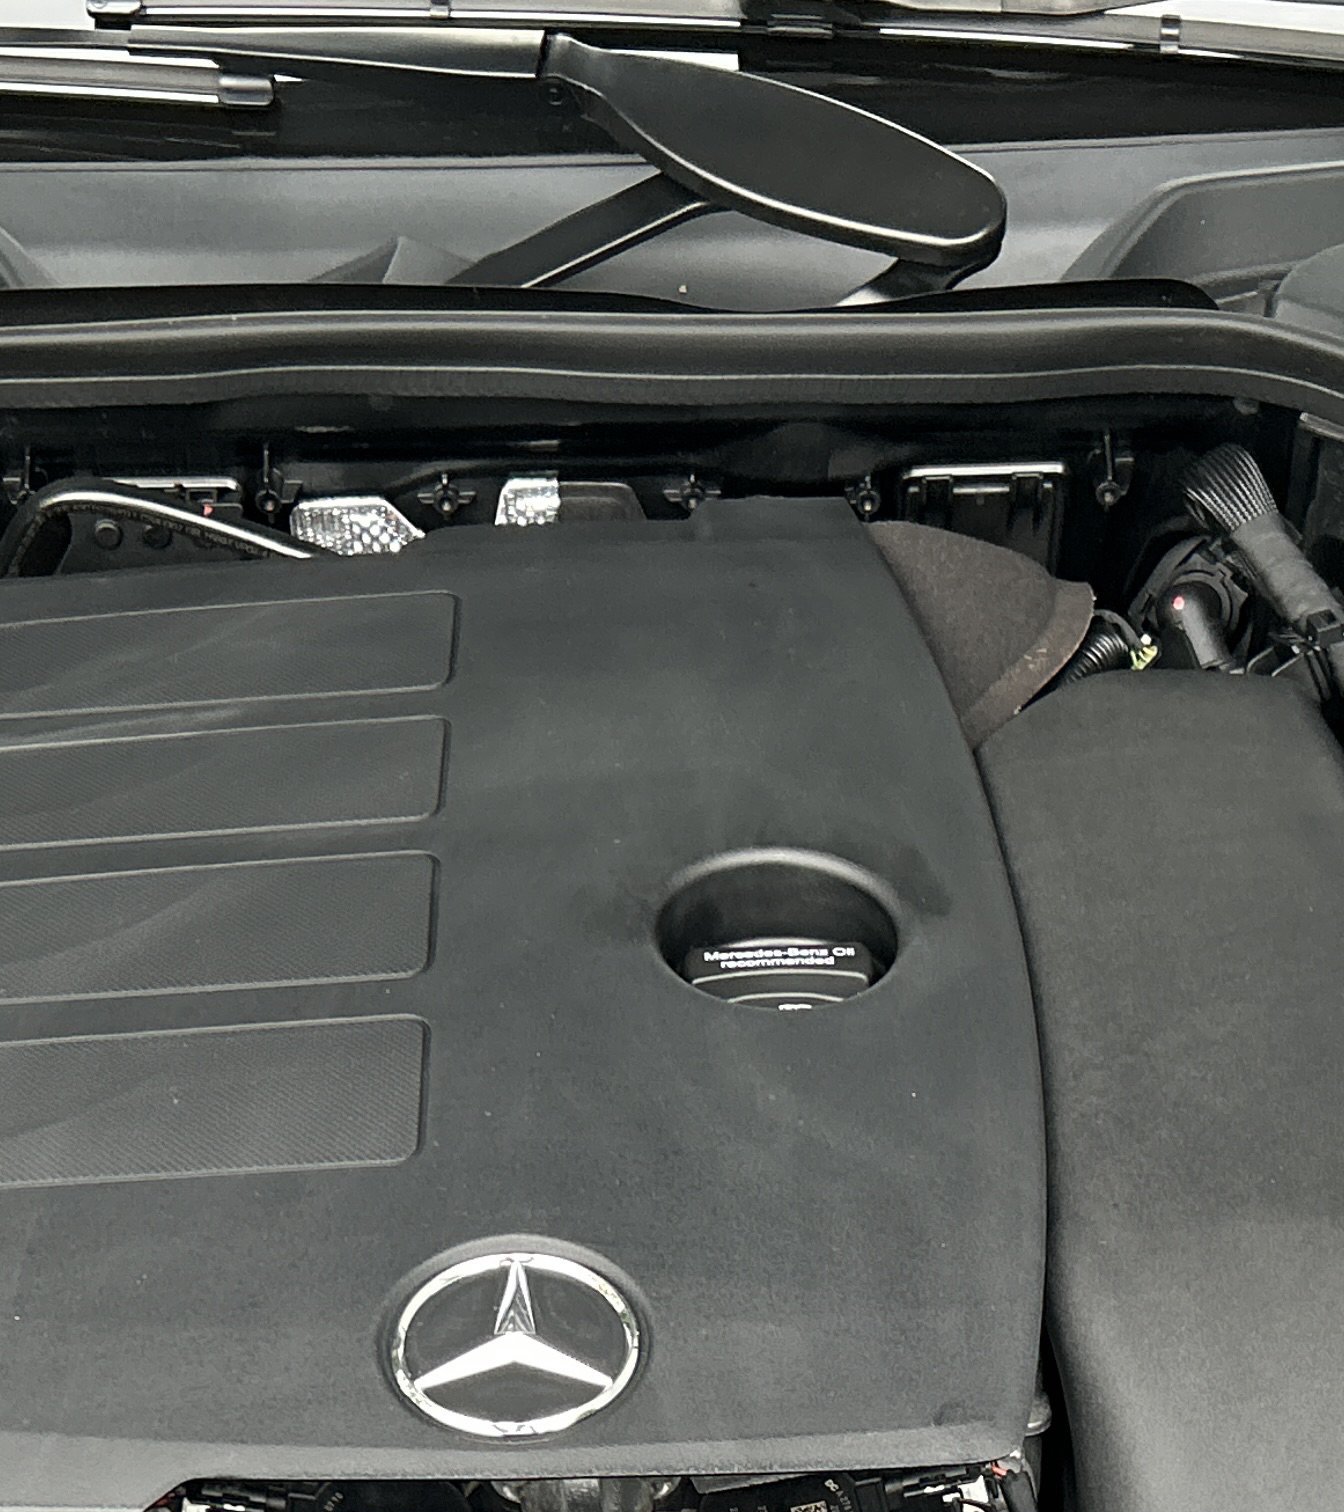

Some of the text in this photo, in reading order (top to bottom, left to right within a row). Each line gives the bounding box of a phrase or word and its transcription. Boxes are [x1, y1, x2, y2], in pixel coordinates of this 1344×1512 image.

[703, 947, 856, 962] Mercedes-Benz Oil
[720, 956, 835, 969] recommended
